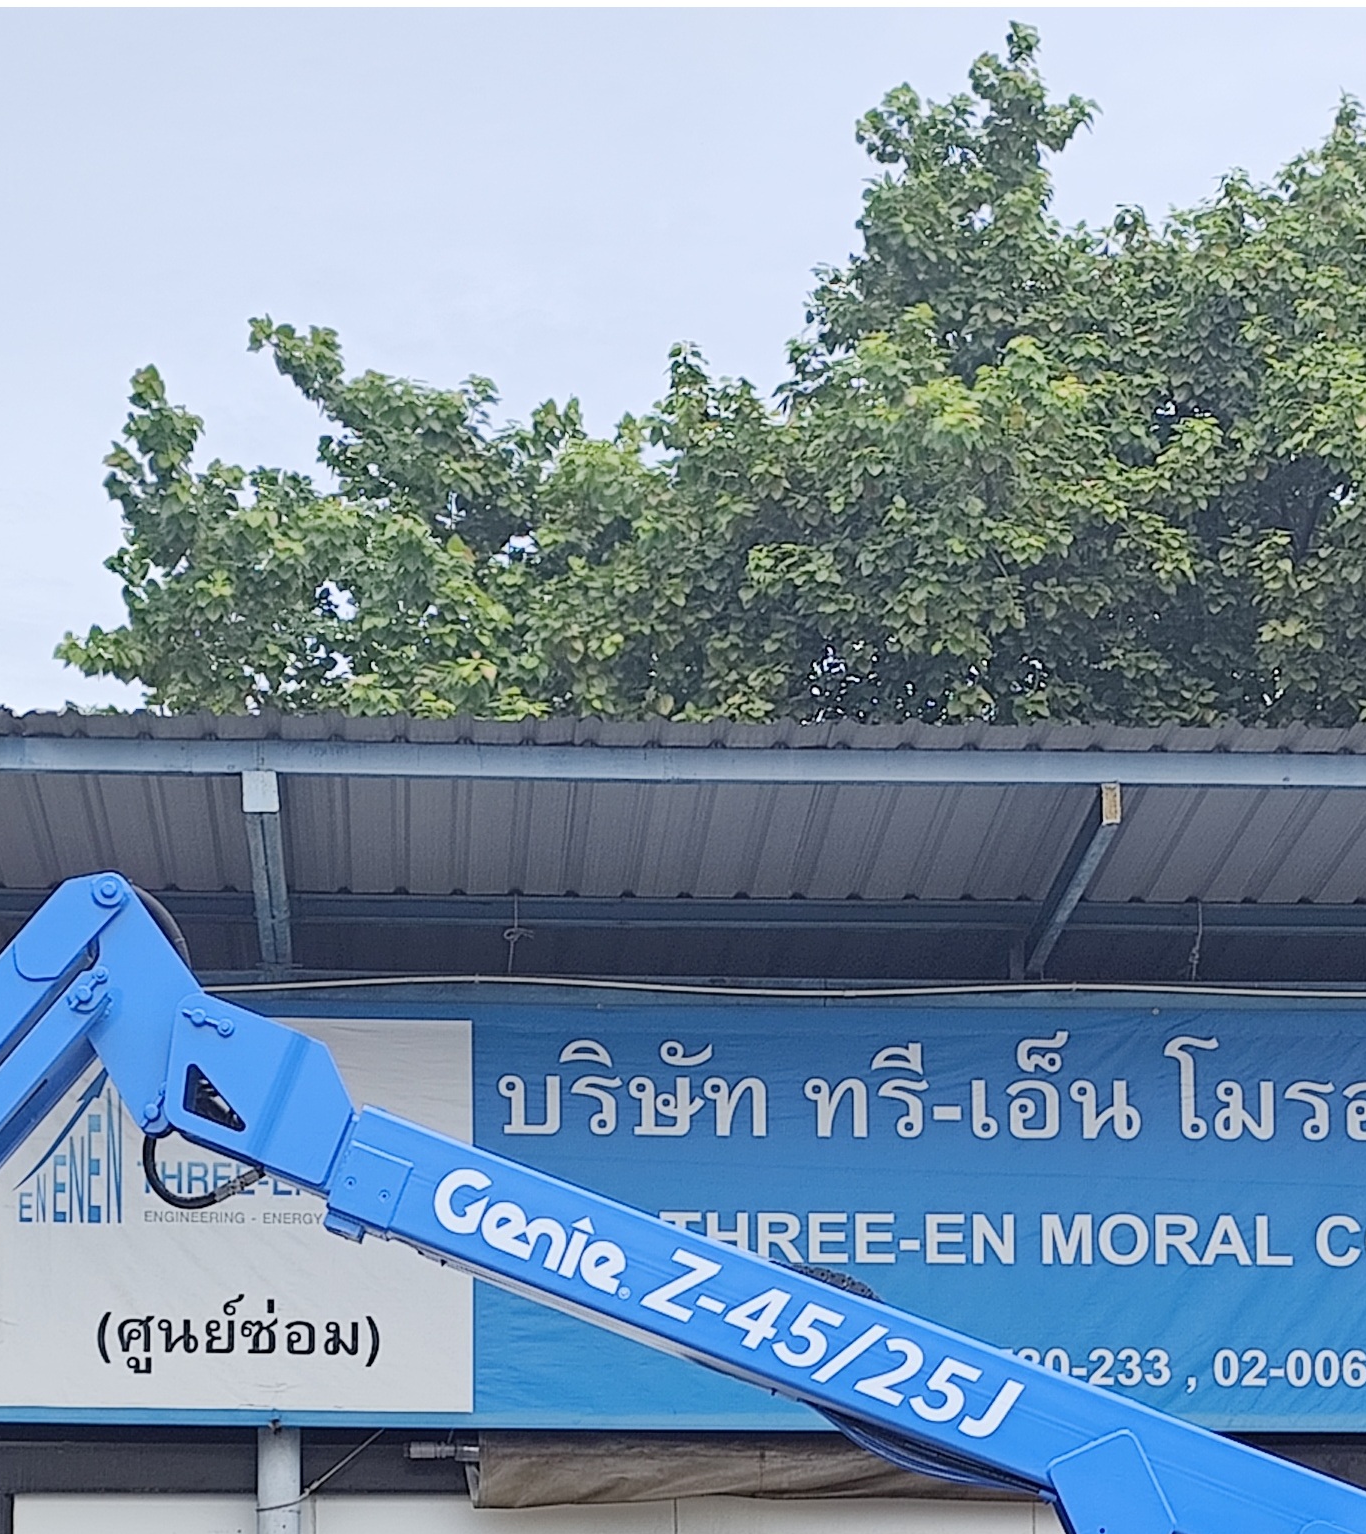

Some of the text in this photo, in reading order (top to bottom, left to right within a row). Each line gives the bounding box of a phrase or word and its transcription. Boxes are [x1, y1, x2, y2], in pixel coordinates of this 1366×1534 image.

[497, 1039, 767, 1137] บริษัท
[804, 1030, 1141, 1141] ทรี-เอ็น
[144, 1210, 245, 1224] ENGINEERING
[263, 1212, 323, 1225] ENERGY
[1041, 1214, 1294, 1266] MORAL
[97, 1294, 381, 1373] (ศูนย์ซ่อม)
[434, 1168, 1024, 1440] Genie Z-45/25J
